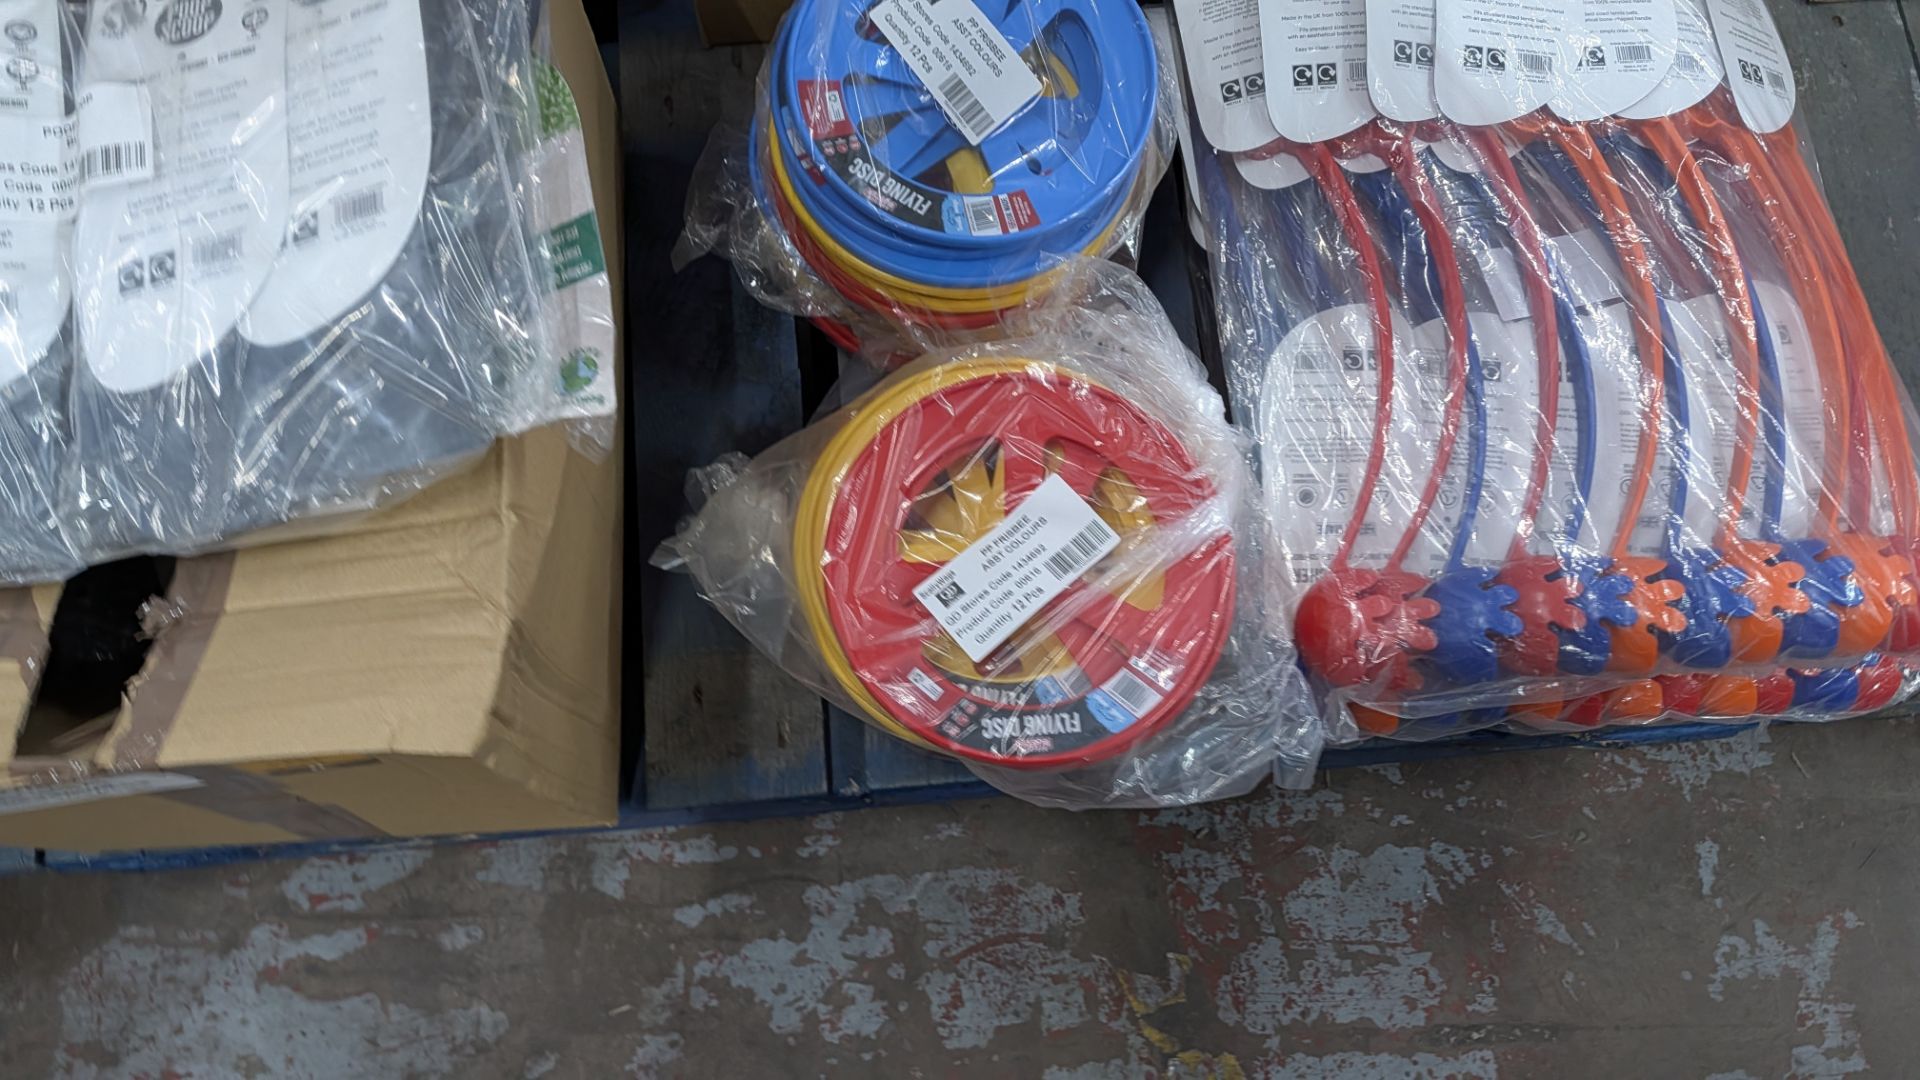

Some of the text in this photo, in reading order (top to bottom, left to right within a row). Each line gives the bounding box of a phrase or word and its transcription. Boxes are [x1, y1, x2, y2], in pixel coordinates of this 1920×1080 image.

[884, 12, 934, 75] Quantity 12 Pcs
[912, 0, 934, 26] Stores
[932, 22, 951, 46] Code
[914, 25, 932, 47] Code
[966, 16, 1007, 63] PP FRISBEE
[951, 17, 1003, 79] ASST COLOURS
[4, 178, 43, 193] Code
[20, 161, 58, 176] Code
[848, 157, 885, 187] DISC
[881, 177, 932, 216] FLYING
[980, 514, 1031, 557] PP FRISBEE
[944, 611, 962, 627] QD
[961, 589, 991, 614] Stores
[988, 570, 1013, 591] Code
[955, 608, 993, 639] Product
[990, 589, 1015, 610] Code
[975, 585, 1045, 645] Quantity 12 Pcs
[1022, 712, 1082, 736] FLYING
